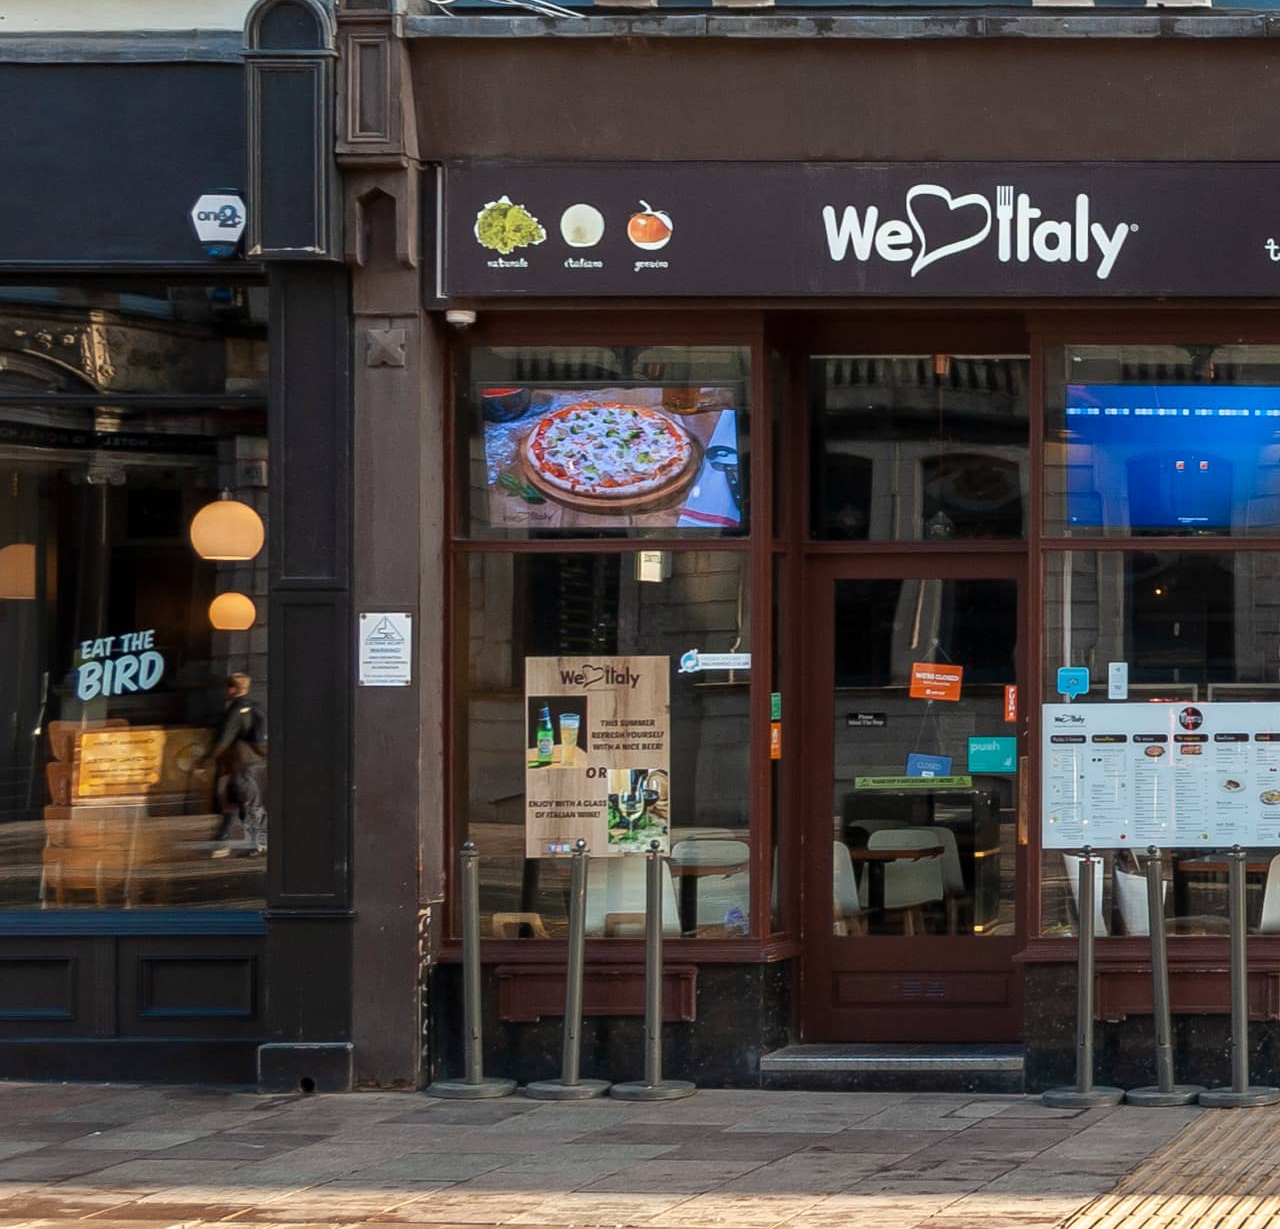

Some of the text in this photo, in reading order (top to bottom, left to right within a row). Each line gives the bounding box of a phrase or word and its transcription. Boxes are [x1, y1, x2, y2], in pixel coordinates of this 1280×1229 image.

[822, 185, 1130, 280] We Italy
[80, 629, 156, 660] EAT THE
[77, 651, 165, 701] BIRD
[561, 667, 640, 688] We Italy
[970, 739, 1000, 753] push
